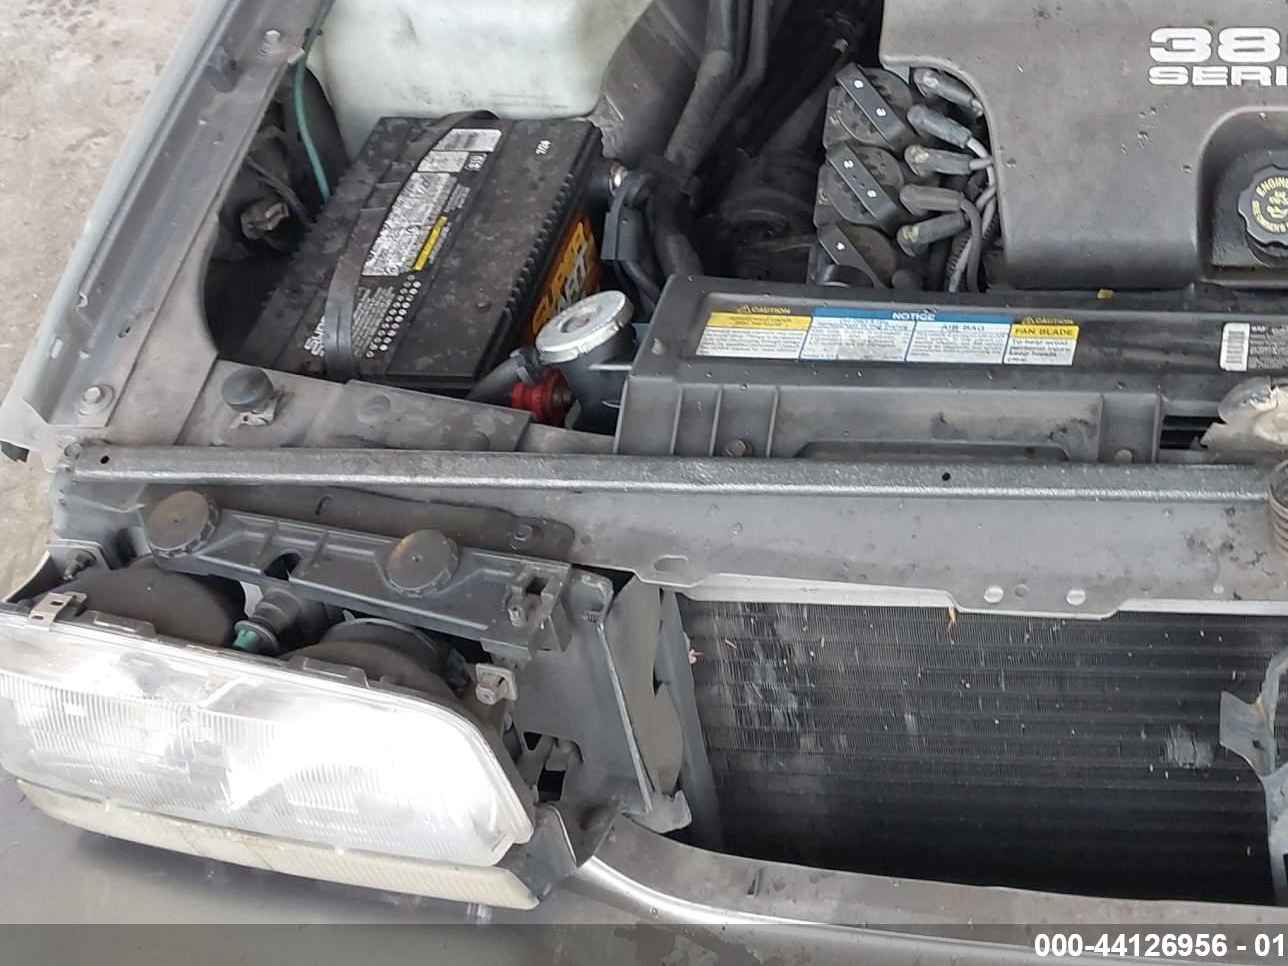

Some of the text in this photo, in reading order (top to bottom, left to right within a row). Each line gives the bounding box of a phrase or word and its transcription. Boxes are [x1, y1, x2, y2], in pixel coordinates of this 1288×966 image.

[892, 312, 936, 321] NOTICE
[1014, 327, 1073, 336] FAN BLADE
